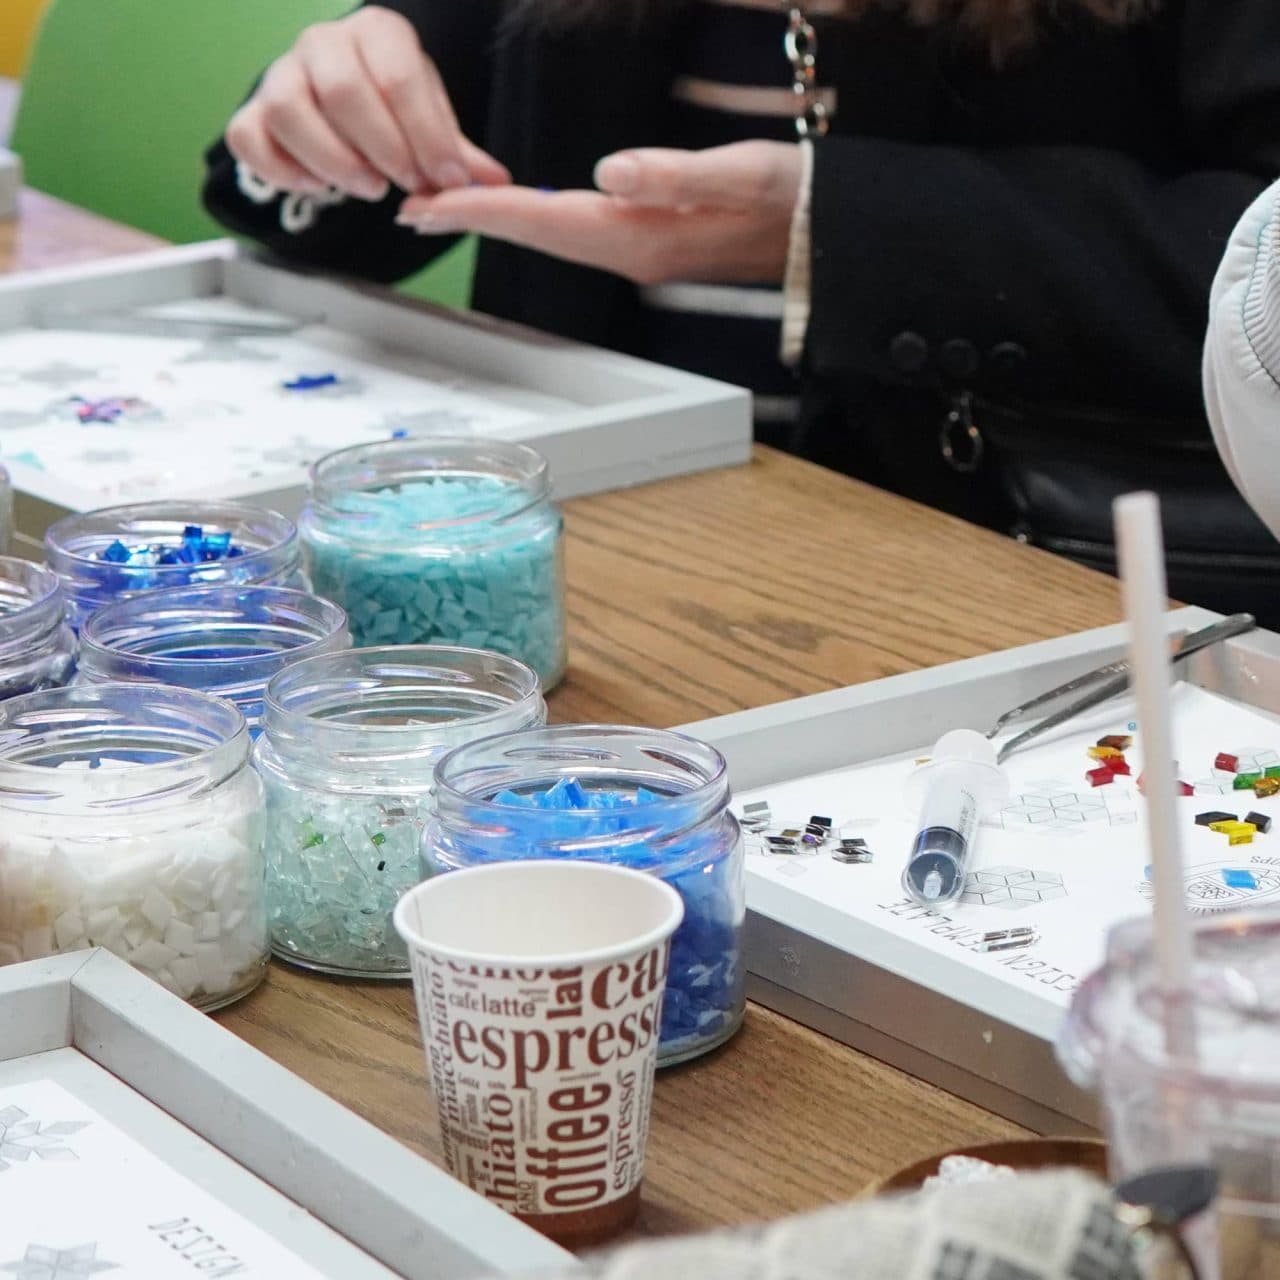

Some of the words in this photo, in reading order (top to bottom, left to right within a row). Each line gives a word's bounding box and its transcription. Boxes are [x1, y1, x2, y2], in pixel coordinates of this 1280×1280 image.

[876, 898, 984, 952] EMPLATE
[996, 953, 1081, 991] ESIGN
[481, 992, 537, 1018] latte
[431, 971, 460, 1123] macchiato
[483, 1092, 518, 1209] hiato
[613, 1071, 636, 1191] espresso
[147, 1217, 245, 1279] DESIGN
